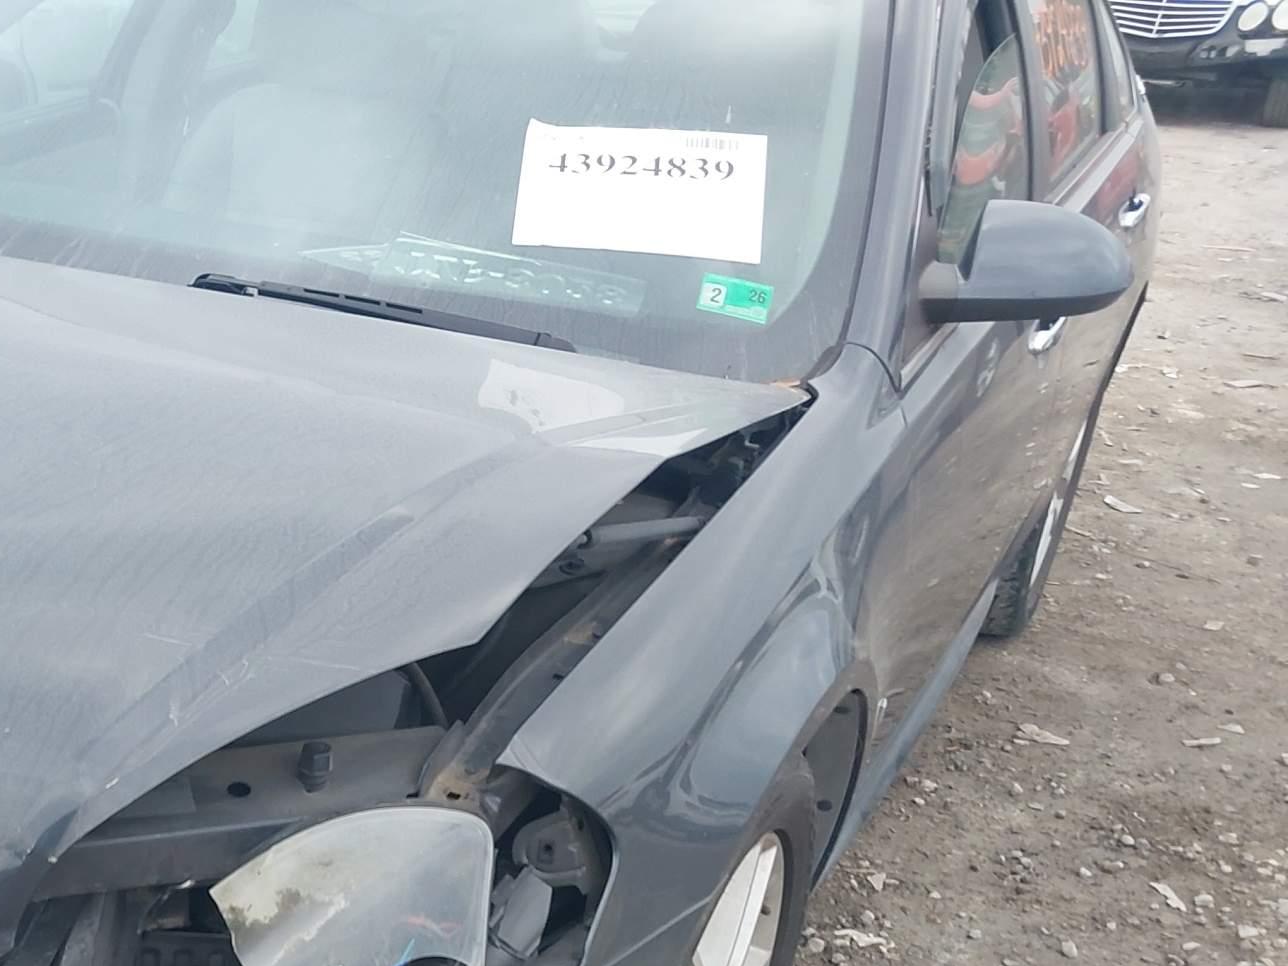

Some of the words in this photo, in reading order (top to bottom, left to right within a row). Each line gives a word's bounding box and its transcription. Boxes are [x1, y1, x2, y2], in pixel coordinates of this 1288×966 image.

[548, 153, 735, 180] 43924839
[710, 287, 722, 304] 2
[748, 288, 768, 305] 26
